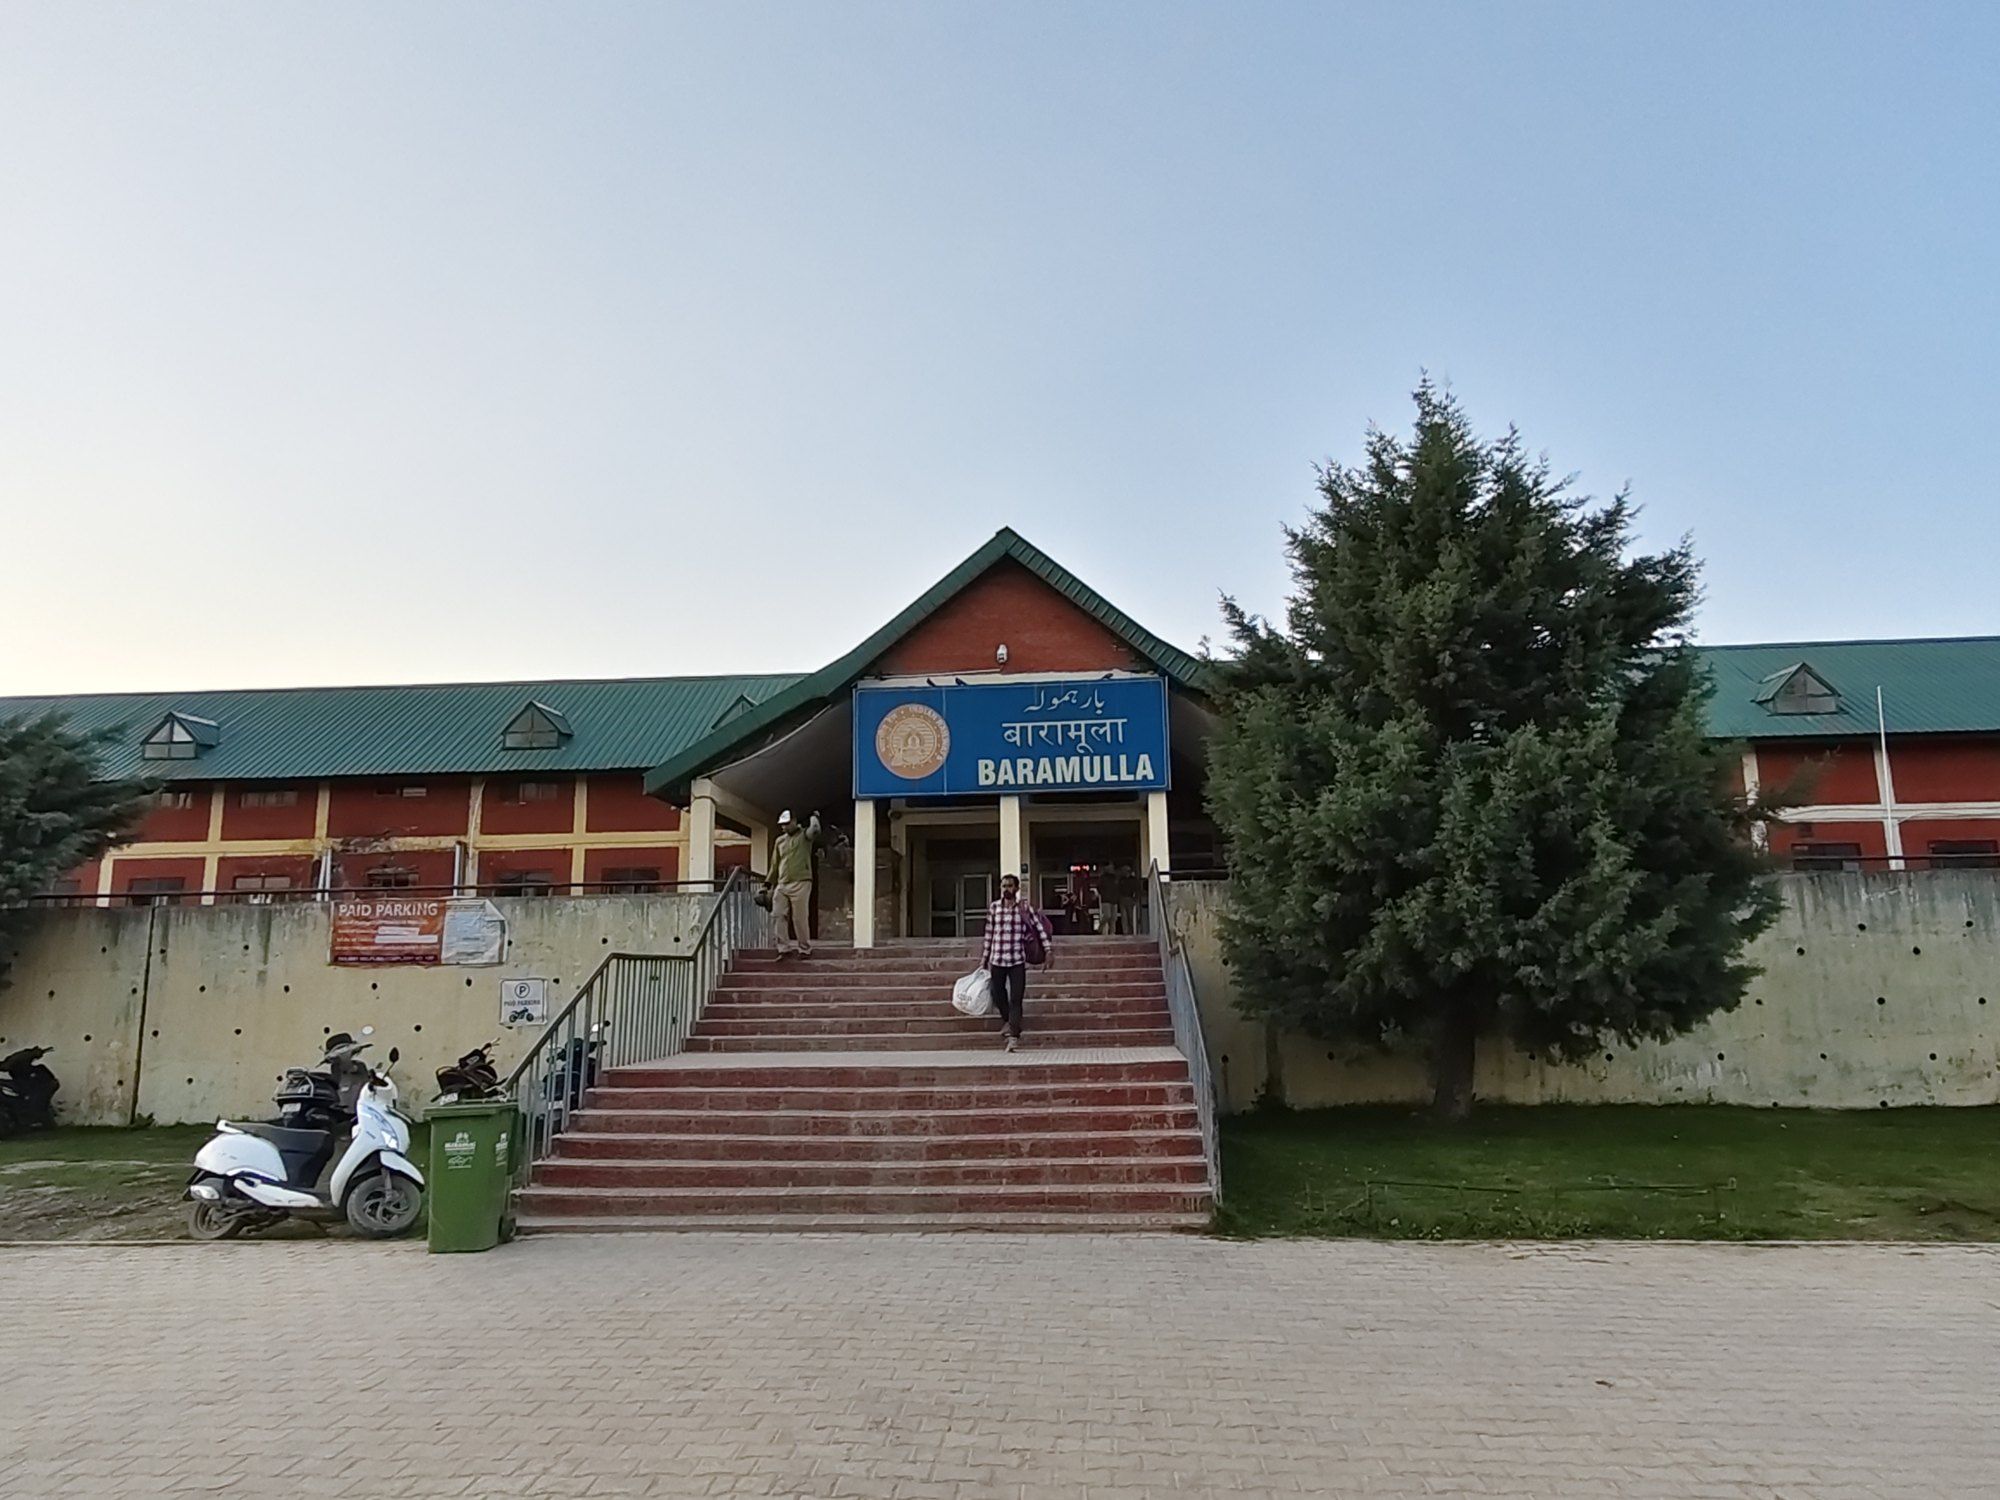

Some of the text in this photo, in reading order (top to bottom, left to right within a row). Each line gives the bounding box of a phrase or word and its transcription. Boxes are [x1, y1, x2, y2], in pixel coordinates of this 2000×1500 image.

[1002, 719, 1128, 753] बारामूला
[978, 754, 1154, 786] BARAMULLA
[339, 903, 438, 917] PAID PARKING
